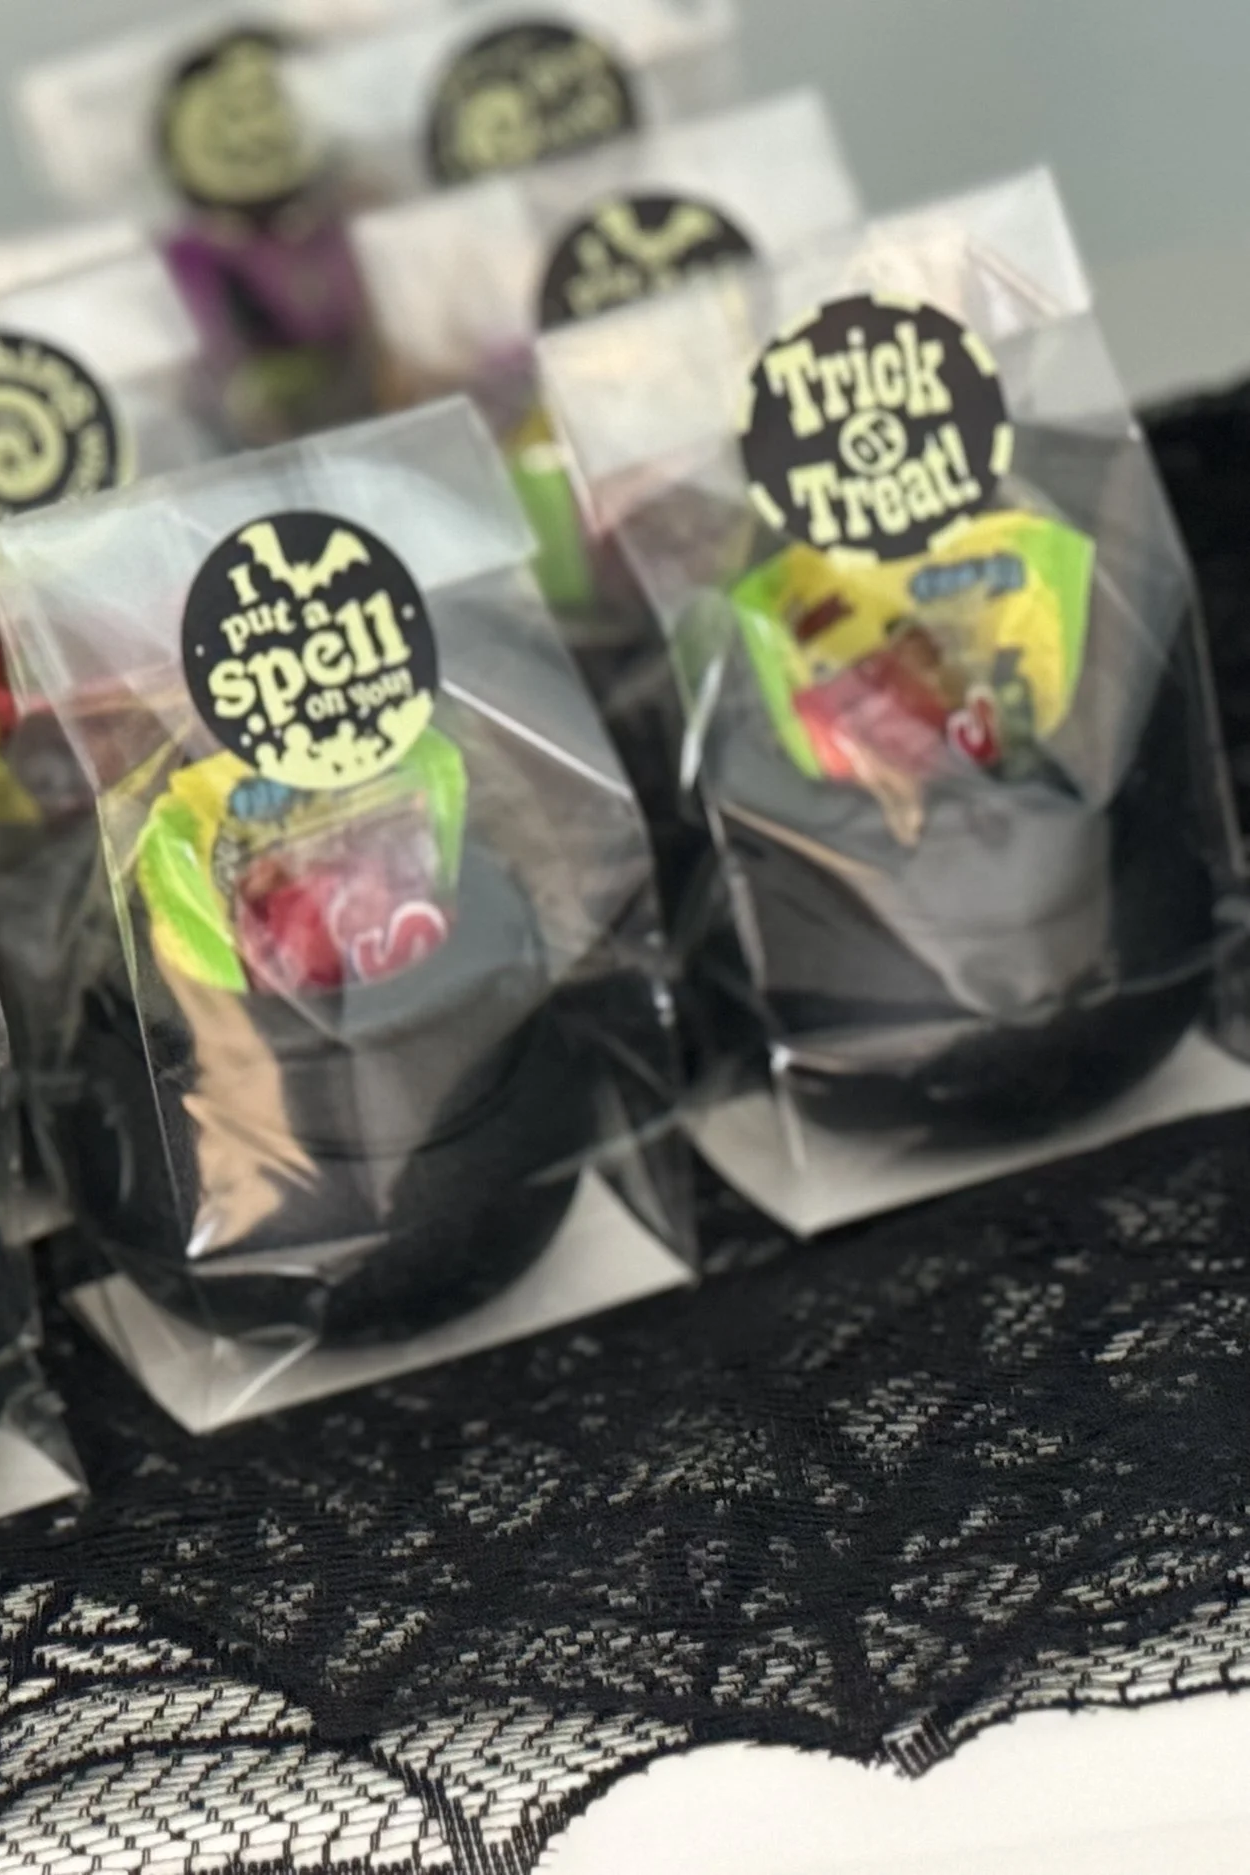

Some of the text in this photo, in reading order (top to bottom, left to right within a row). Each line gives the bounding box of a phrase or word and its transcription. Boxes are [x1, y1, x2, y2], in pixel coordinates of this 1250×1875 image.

[762, 321, 953, 439] Trick
[849, 416, 898, 466] or
[787, 420, 982, 546] Treat!
[227, 562, 260, 607] I
[219, 597, 332, 655] put a
[207, 588, 412, 728] spell
[304, 687, 348, 722] on
